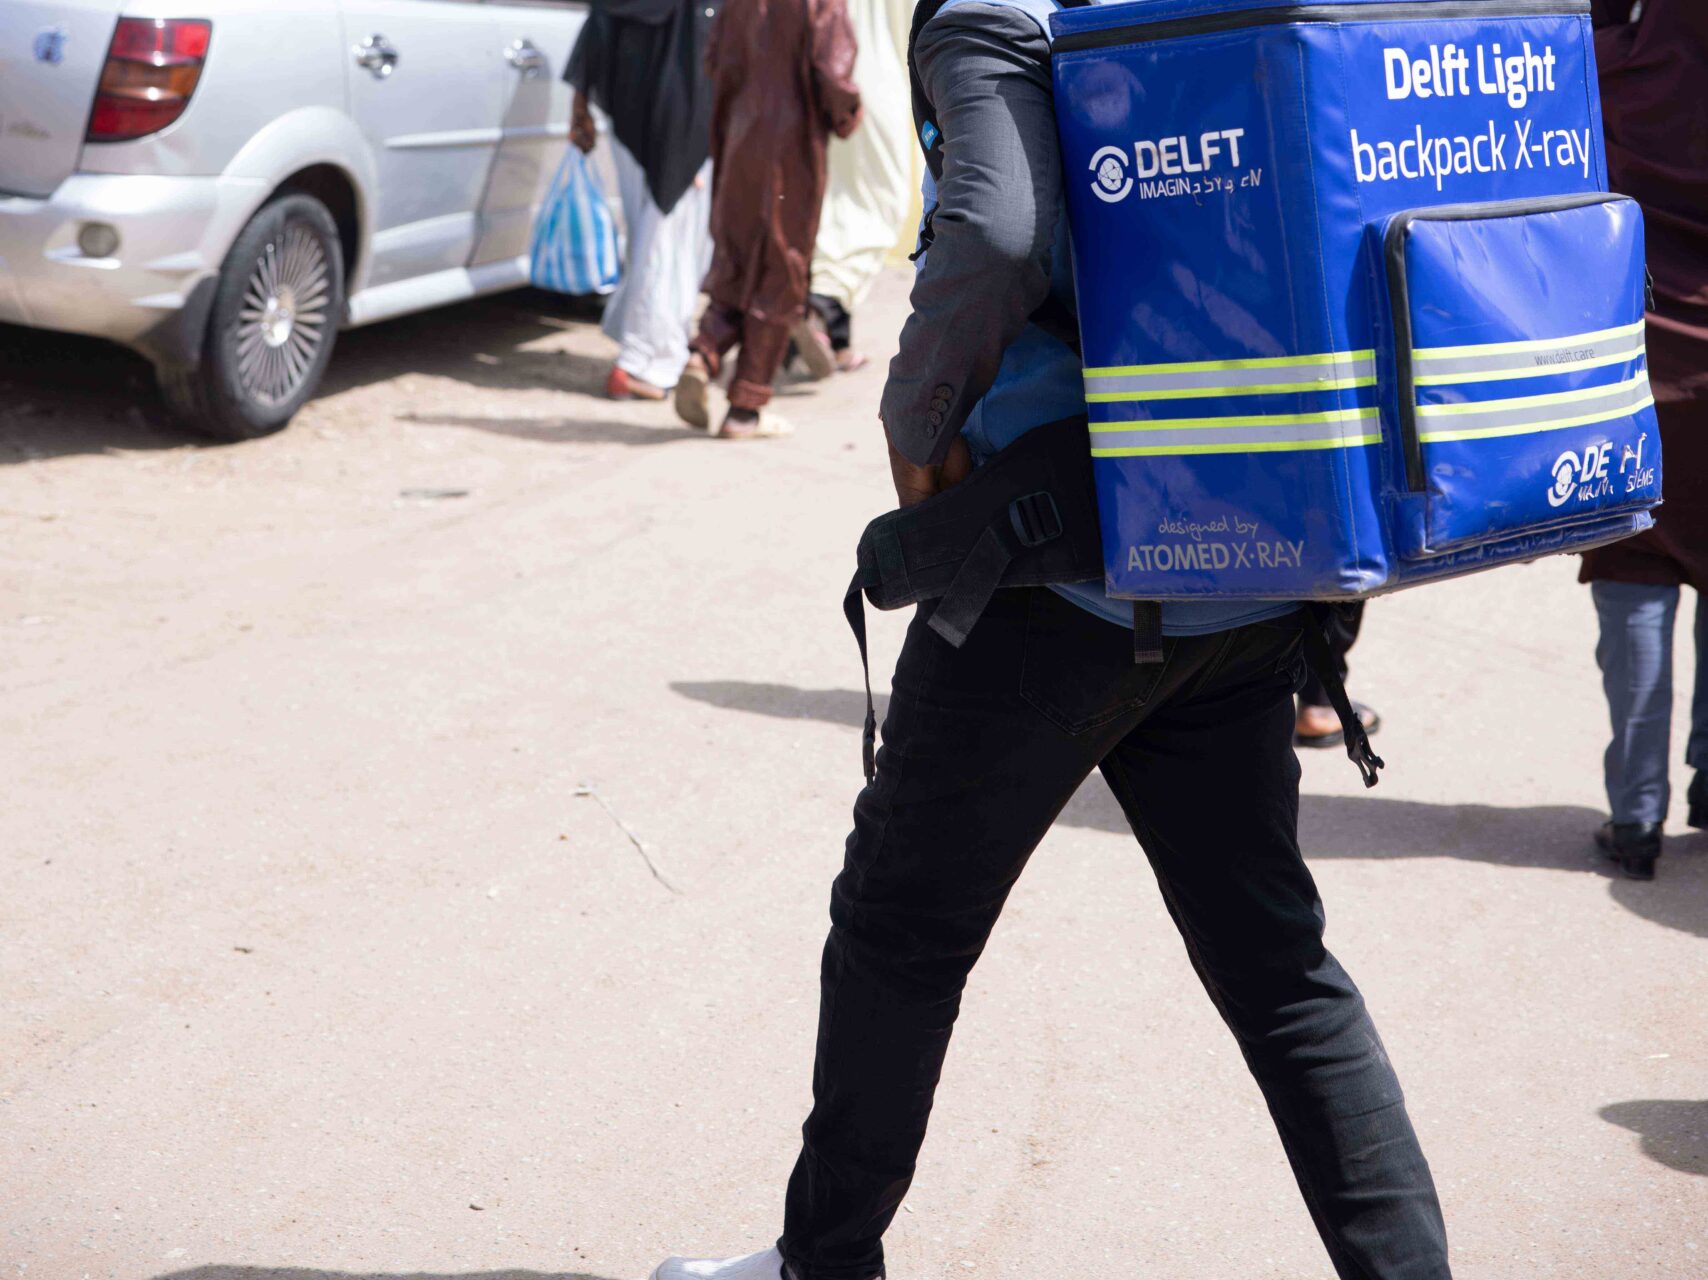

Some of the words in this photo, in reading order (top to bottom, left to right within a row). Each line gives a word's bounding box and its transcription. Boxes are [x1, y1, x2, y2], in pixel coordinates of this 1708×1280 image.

[1383, 43, 1470, 100] Delft
[1477, 42, 1556, 109] Light
[1134, 128, 1244, 179] DELFT
[1350, 120, 1506, 191] backpack
[1514, 119, 1590, 179] X-ray
[1534, 348, 1596, 366] www.delft.care
[1158, 515, 1231, 542] designed
[1235, 516, 1259, 538] by
[1127, 542, 1230, 572] ATOMED
